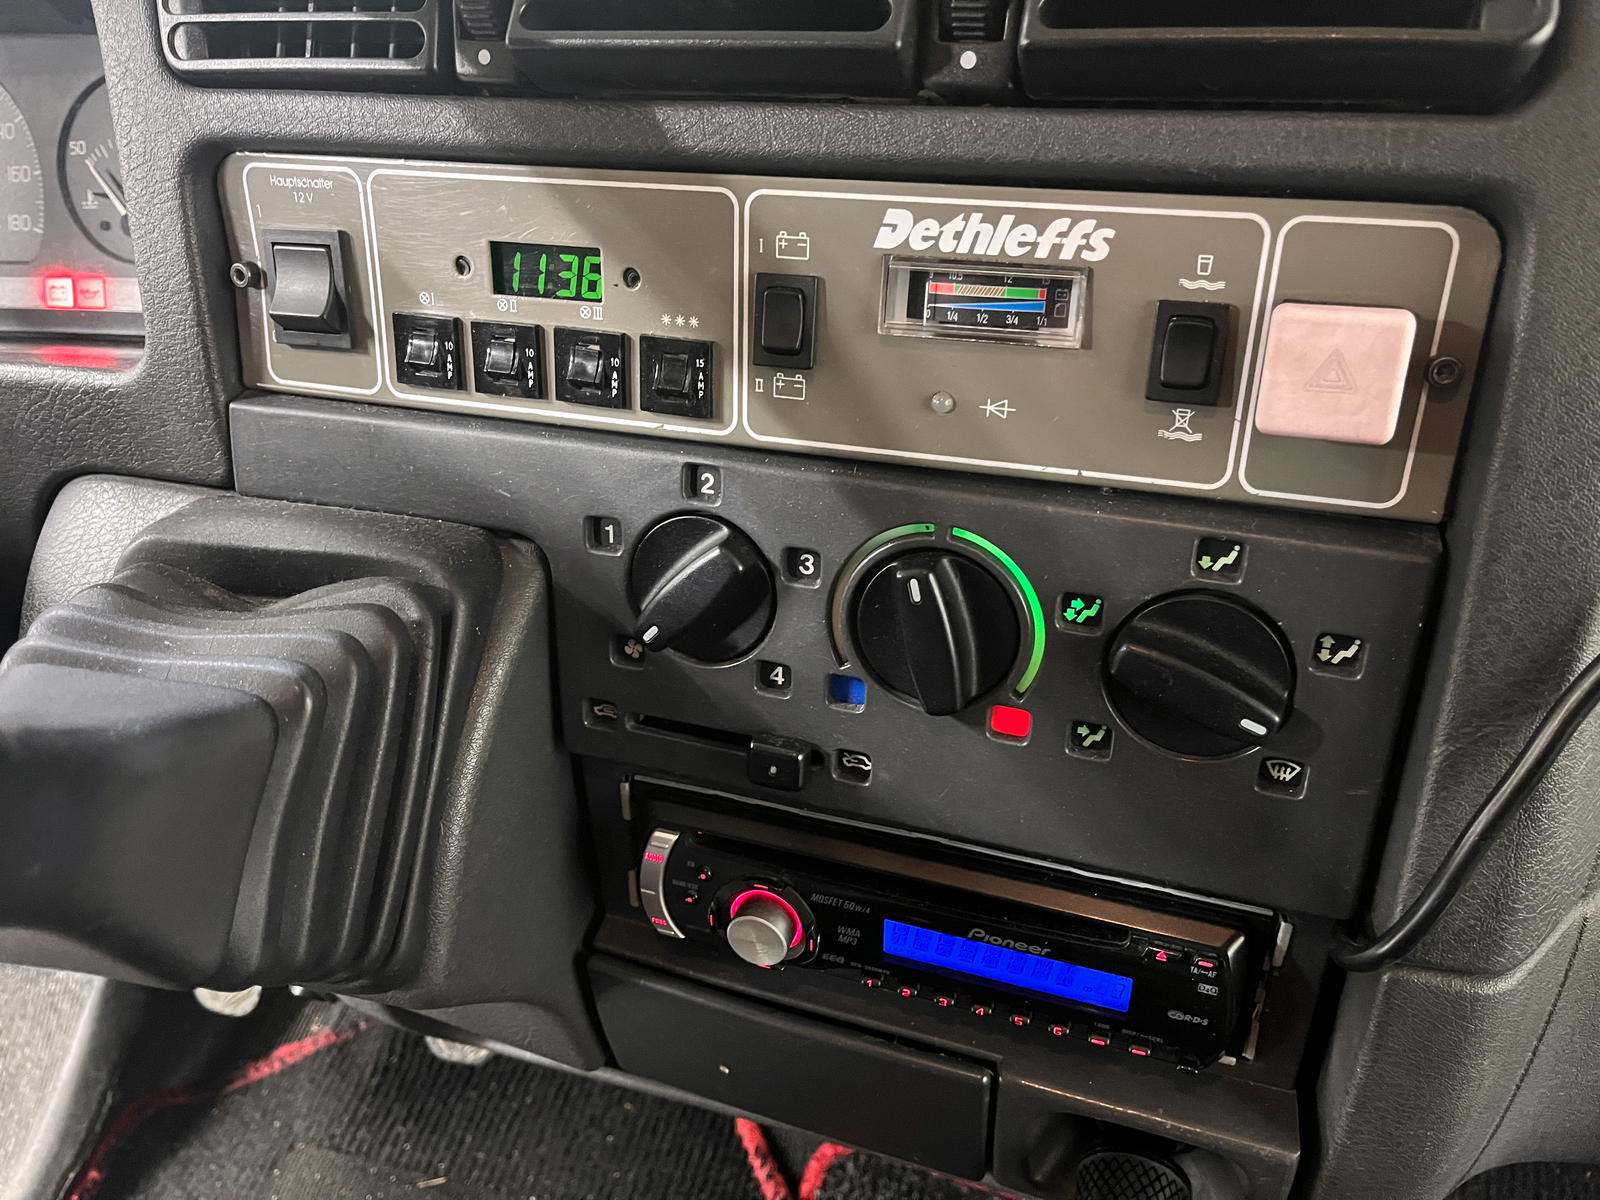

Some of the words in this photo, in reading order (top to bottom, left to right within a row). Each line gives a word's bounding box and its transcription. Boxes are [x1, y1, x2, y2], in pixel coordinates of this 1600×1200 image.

[69, 140, 87, 155] 50
[7, 165, 31, 182] 160
[269, 175, 333, 189] Hauptschalter
[7, 214, 32, 231] 180
[873, 208, 1116, 262] Dethleffs
[946, 310, 958, 322] 1/4
[976, 313, 989, 324] 1/2
[1005, 314, 1019, 326] 3/4
[444, 341, 454, 351] 10
[525, 348, 535, 358] 10
[610, 357, 620, 368] 10
[695, 358, 705, 369] 15
[700, 472, 715, 495] 2
[605, 524, 614, 543] 1
[798, 553, 815, 575] 3
[769, 666, 785, 686] 4
[810, 892, 844, 908] MOSFET
[837, 925, 861, 938] WMA
[837, 934, 858, 946] MP3
[966, 927, 1052, 956] Pioneer
[902, 988, 910, 997] 2
[938, 998, 947, 1007] 3
[1014, 1016, 1023, 1026] 5
[1053, 1026, 1062, 1036] 6
